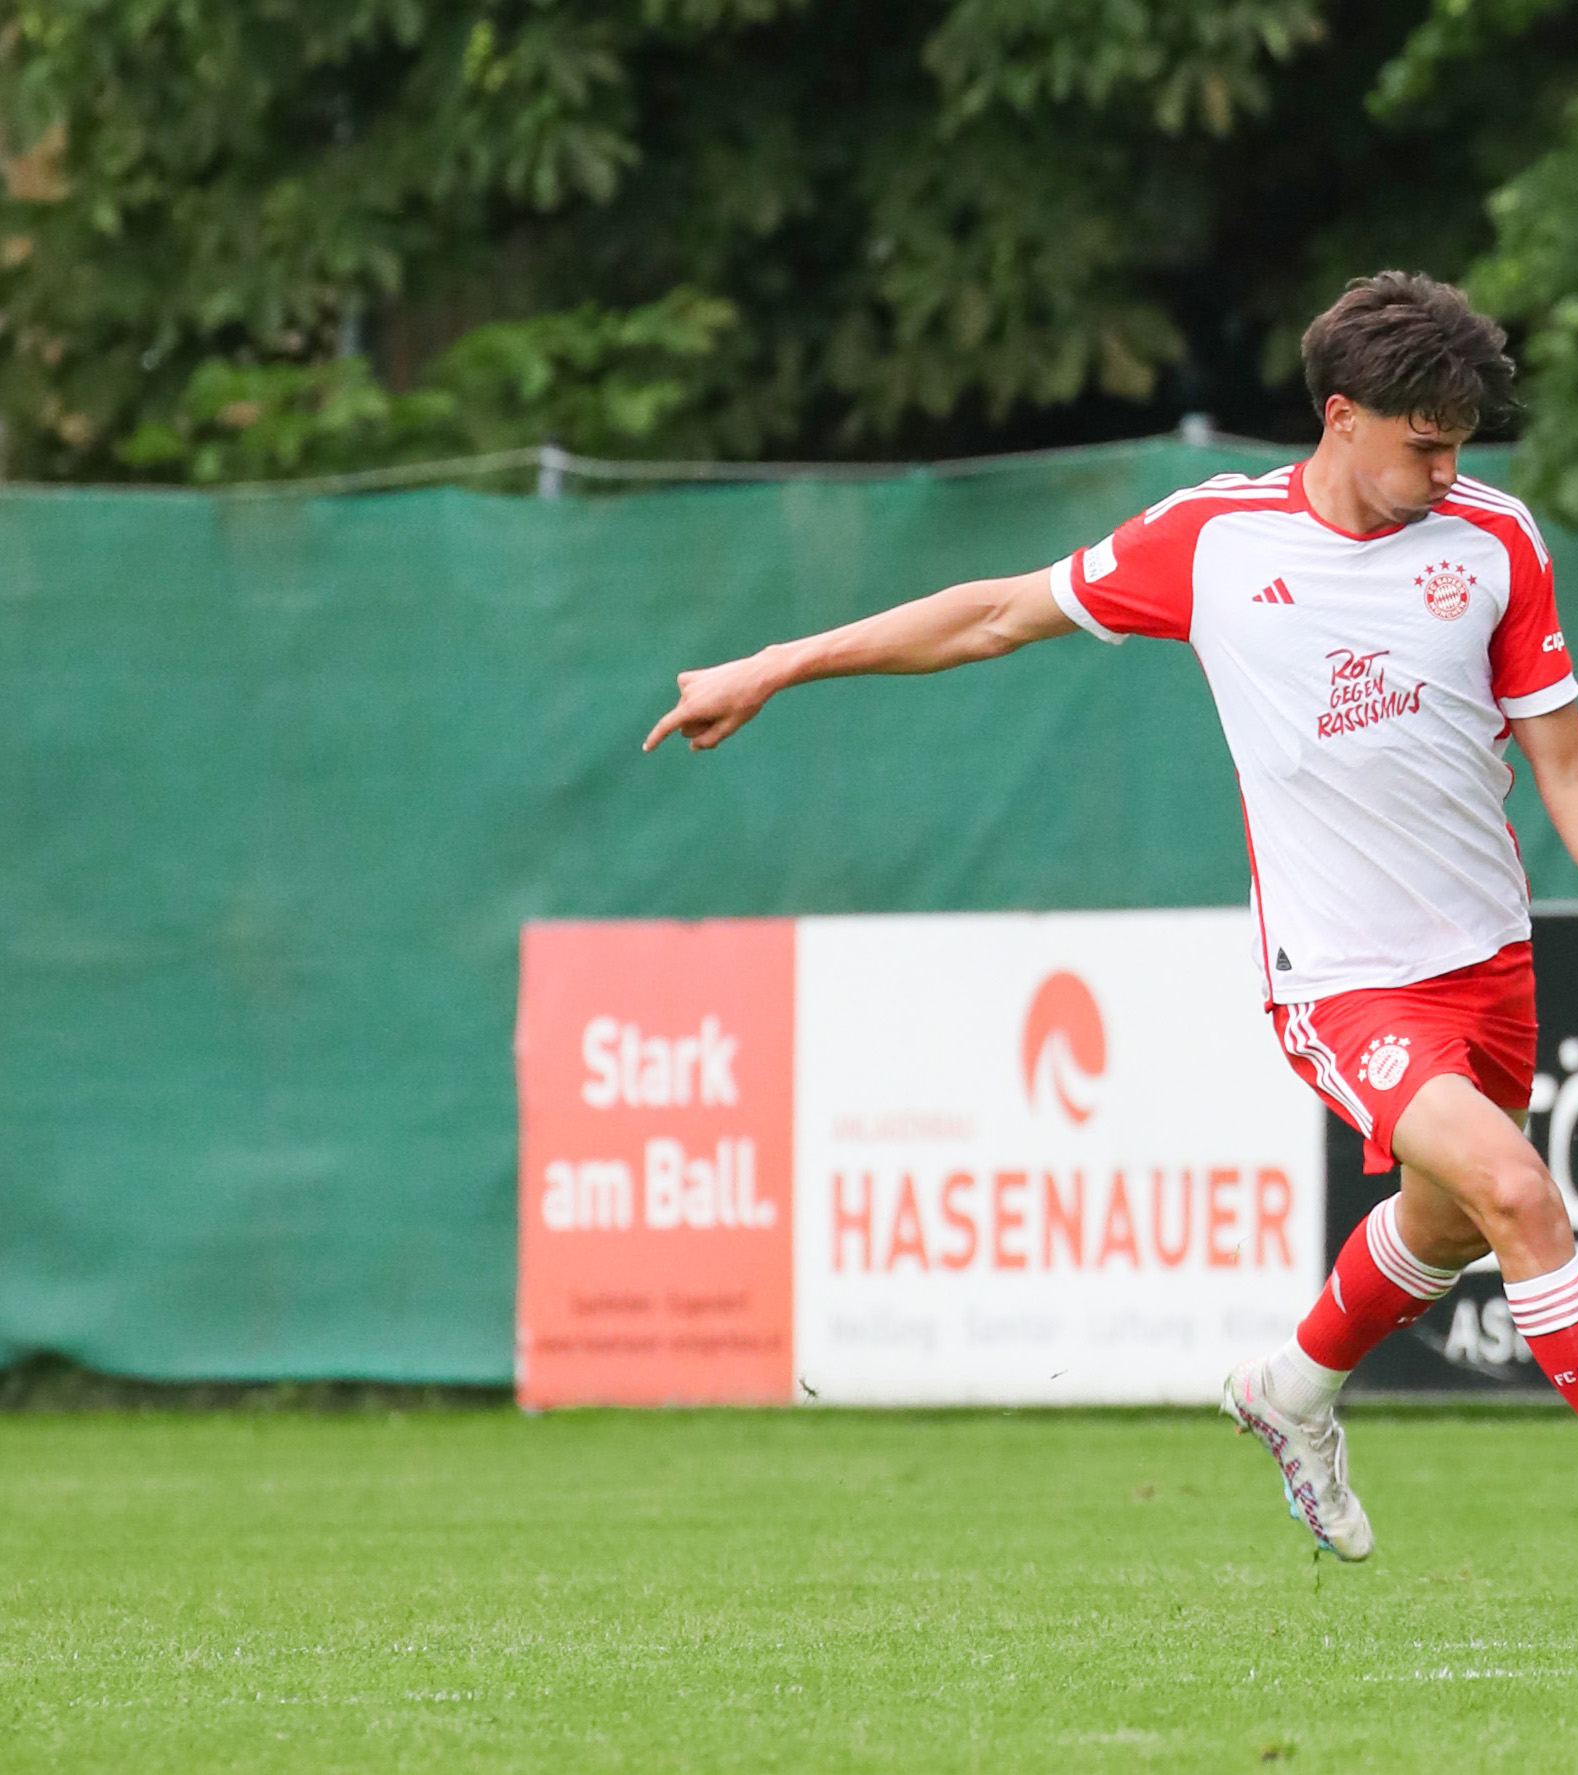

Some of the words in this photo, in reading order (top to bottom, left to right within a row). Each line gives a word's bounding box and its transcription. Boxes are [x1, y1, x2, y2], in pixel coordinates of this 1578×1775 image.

[1325, 648, 1390, 686] ROT
[1330, 667, 1384, 709] GEGEN
[1316, 681, 1427, 739] RASSISMUS
[582, 1013, 738, 1108] Stark
[543, 1157, 632, 1231] am
[644, 1137, 776, 1231] Ball.
[831, 1166, 1296, 1273] HASENAUER
[1553, 1370, 1577, 1387] FC
